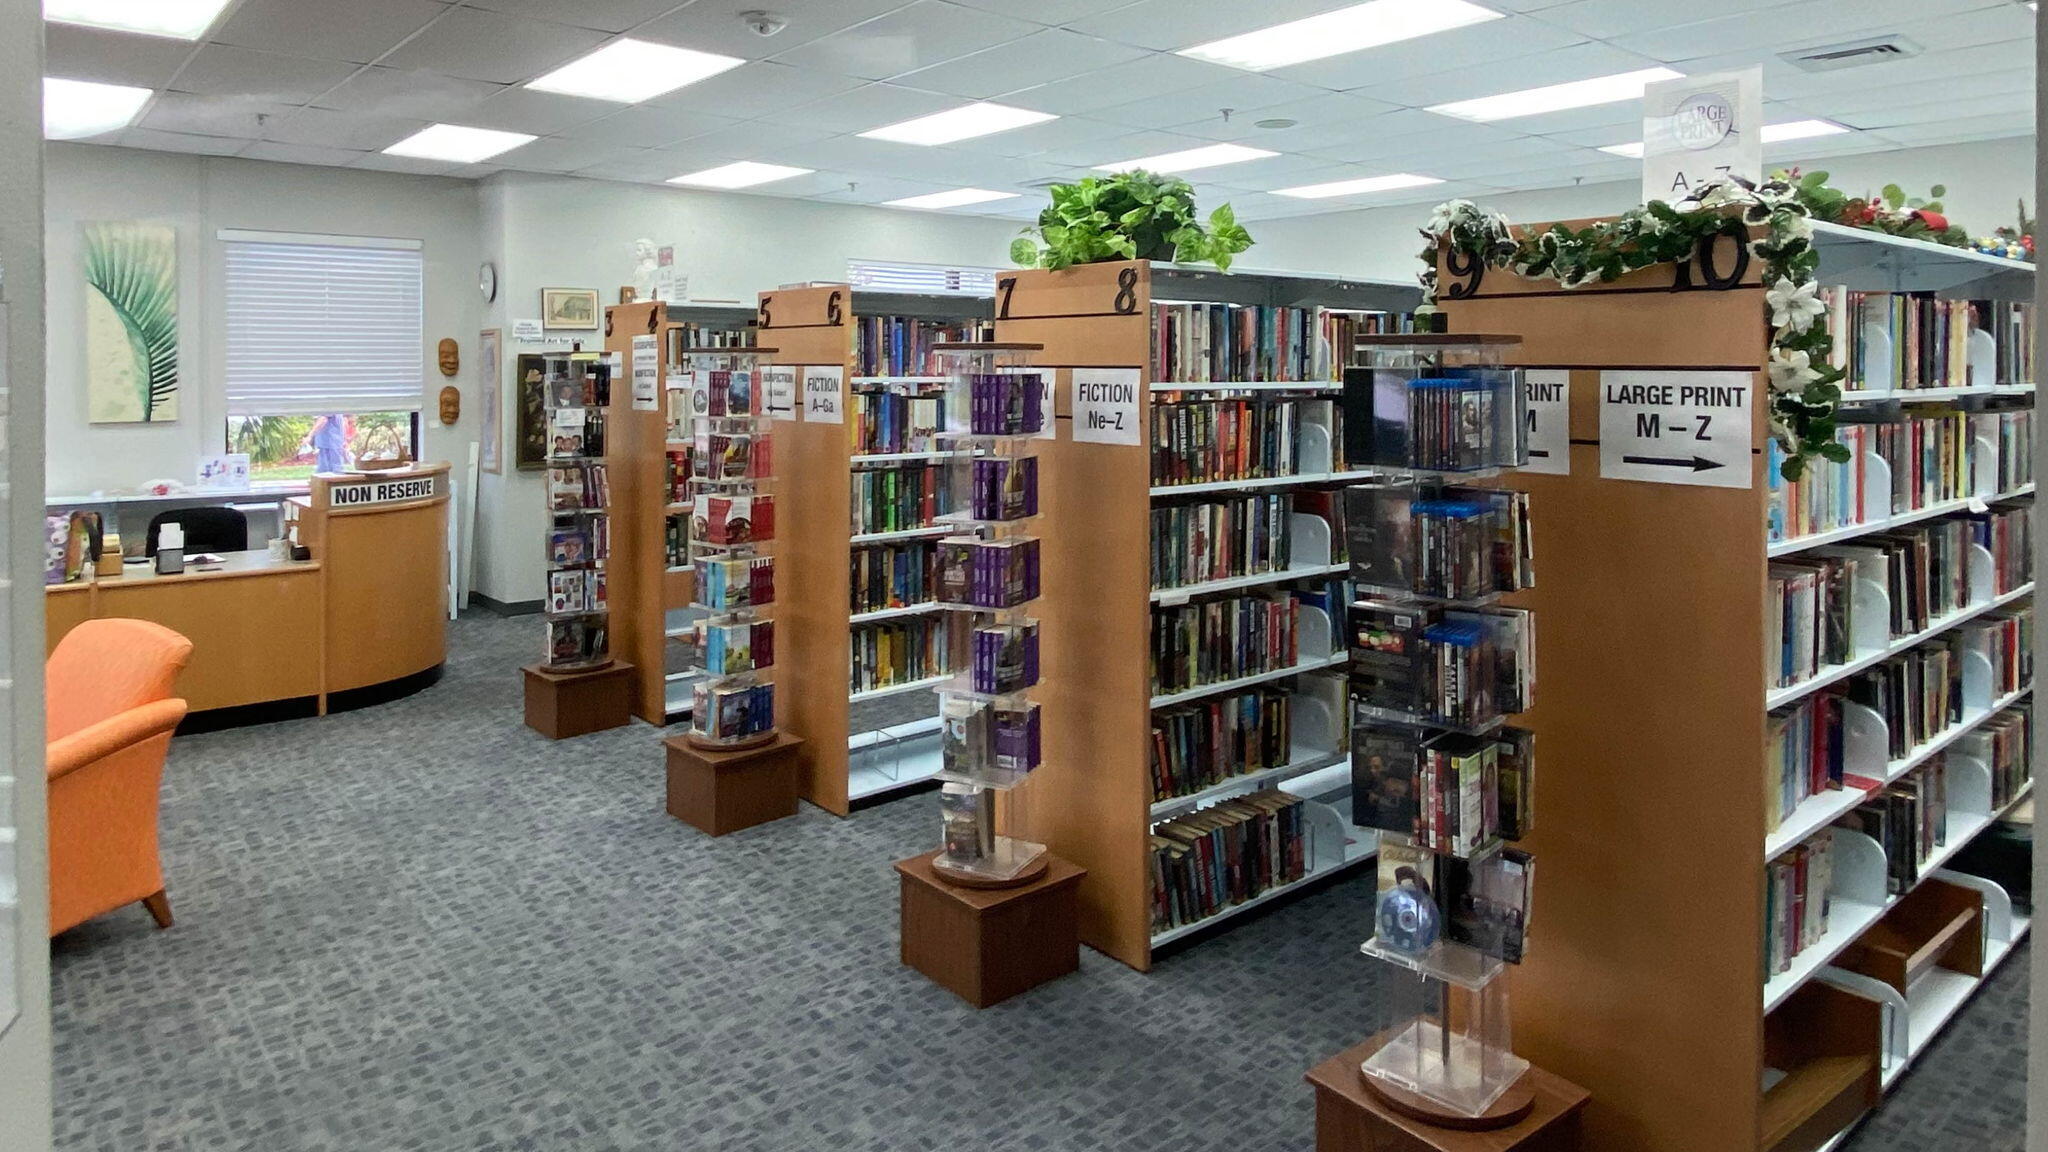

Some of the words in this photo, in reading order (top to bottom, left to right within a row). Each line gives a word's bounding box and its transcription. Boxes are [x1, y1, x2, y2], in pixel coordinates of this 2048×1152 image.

[1680, 104, 1728, 123] ARGE
[1671, 171, 1689, 192] A
[998, 277, 1017, 319] 7
[1114, 268, 1138, 314] 8
[759, 297, 772, 329] 5
[827, 291, 841, 326] 6
[605, 310, 614, 337] 3
[806, 377, 839, 392] FICTION
[1079, 383, 1133, 403] FICTION
[1525, 383, 1564, 402] RINT
[1607, 384, 1674, 406] LARGE
[1680, 386, 1746, 408] PRINT
[1636, 413, 1660, 438] M
[1695, 415, 1712, 441] Z
[335, 485, 372, 504] NON
[377, 480, 432, 501] RESERVE
